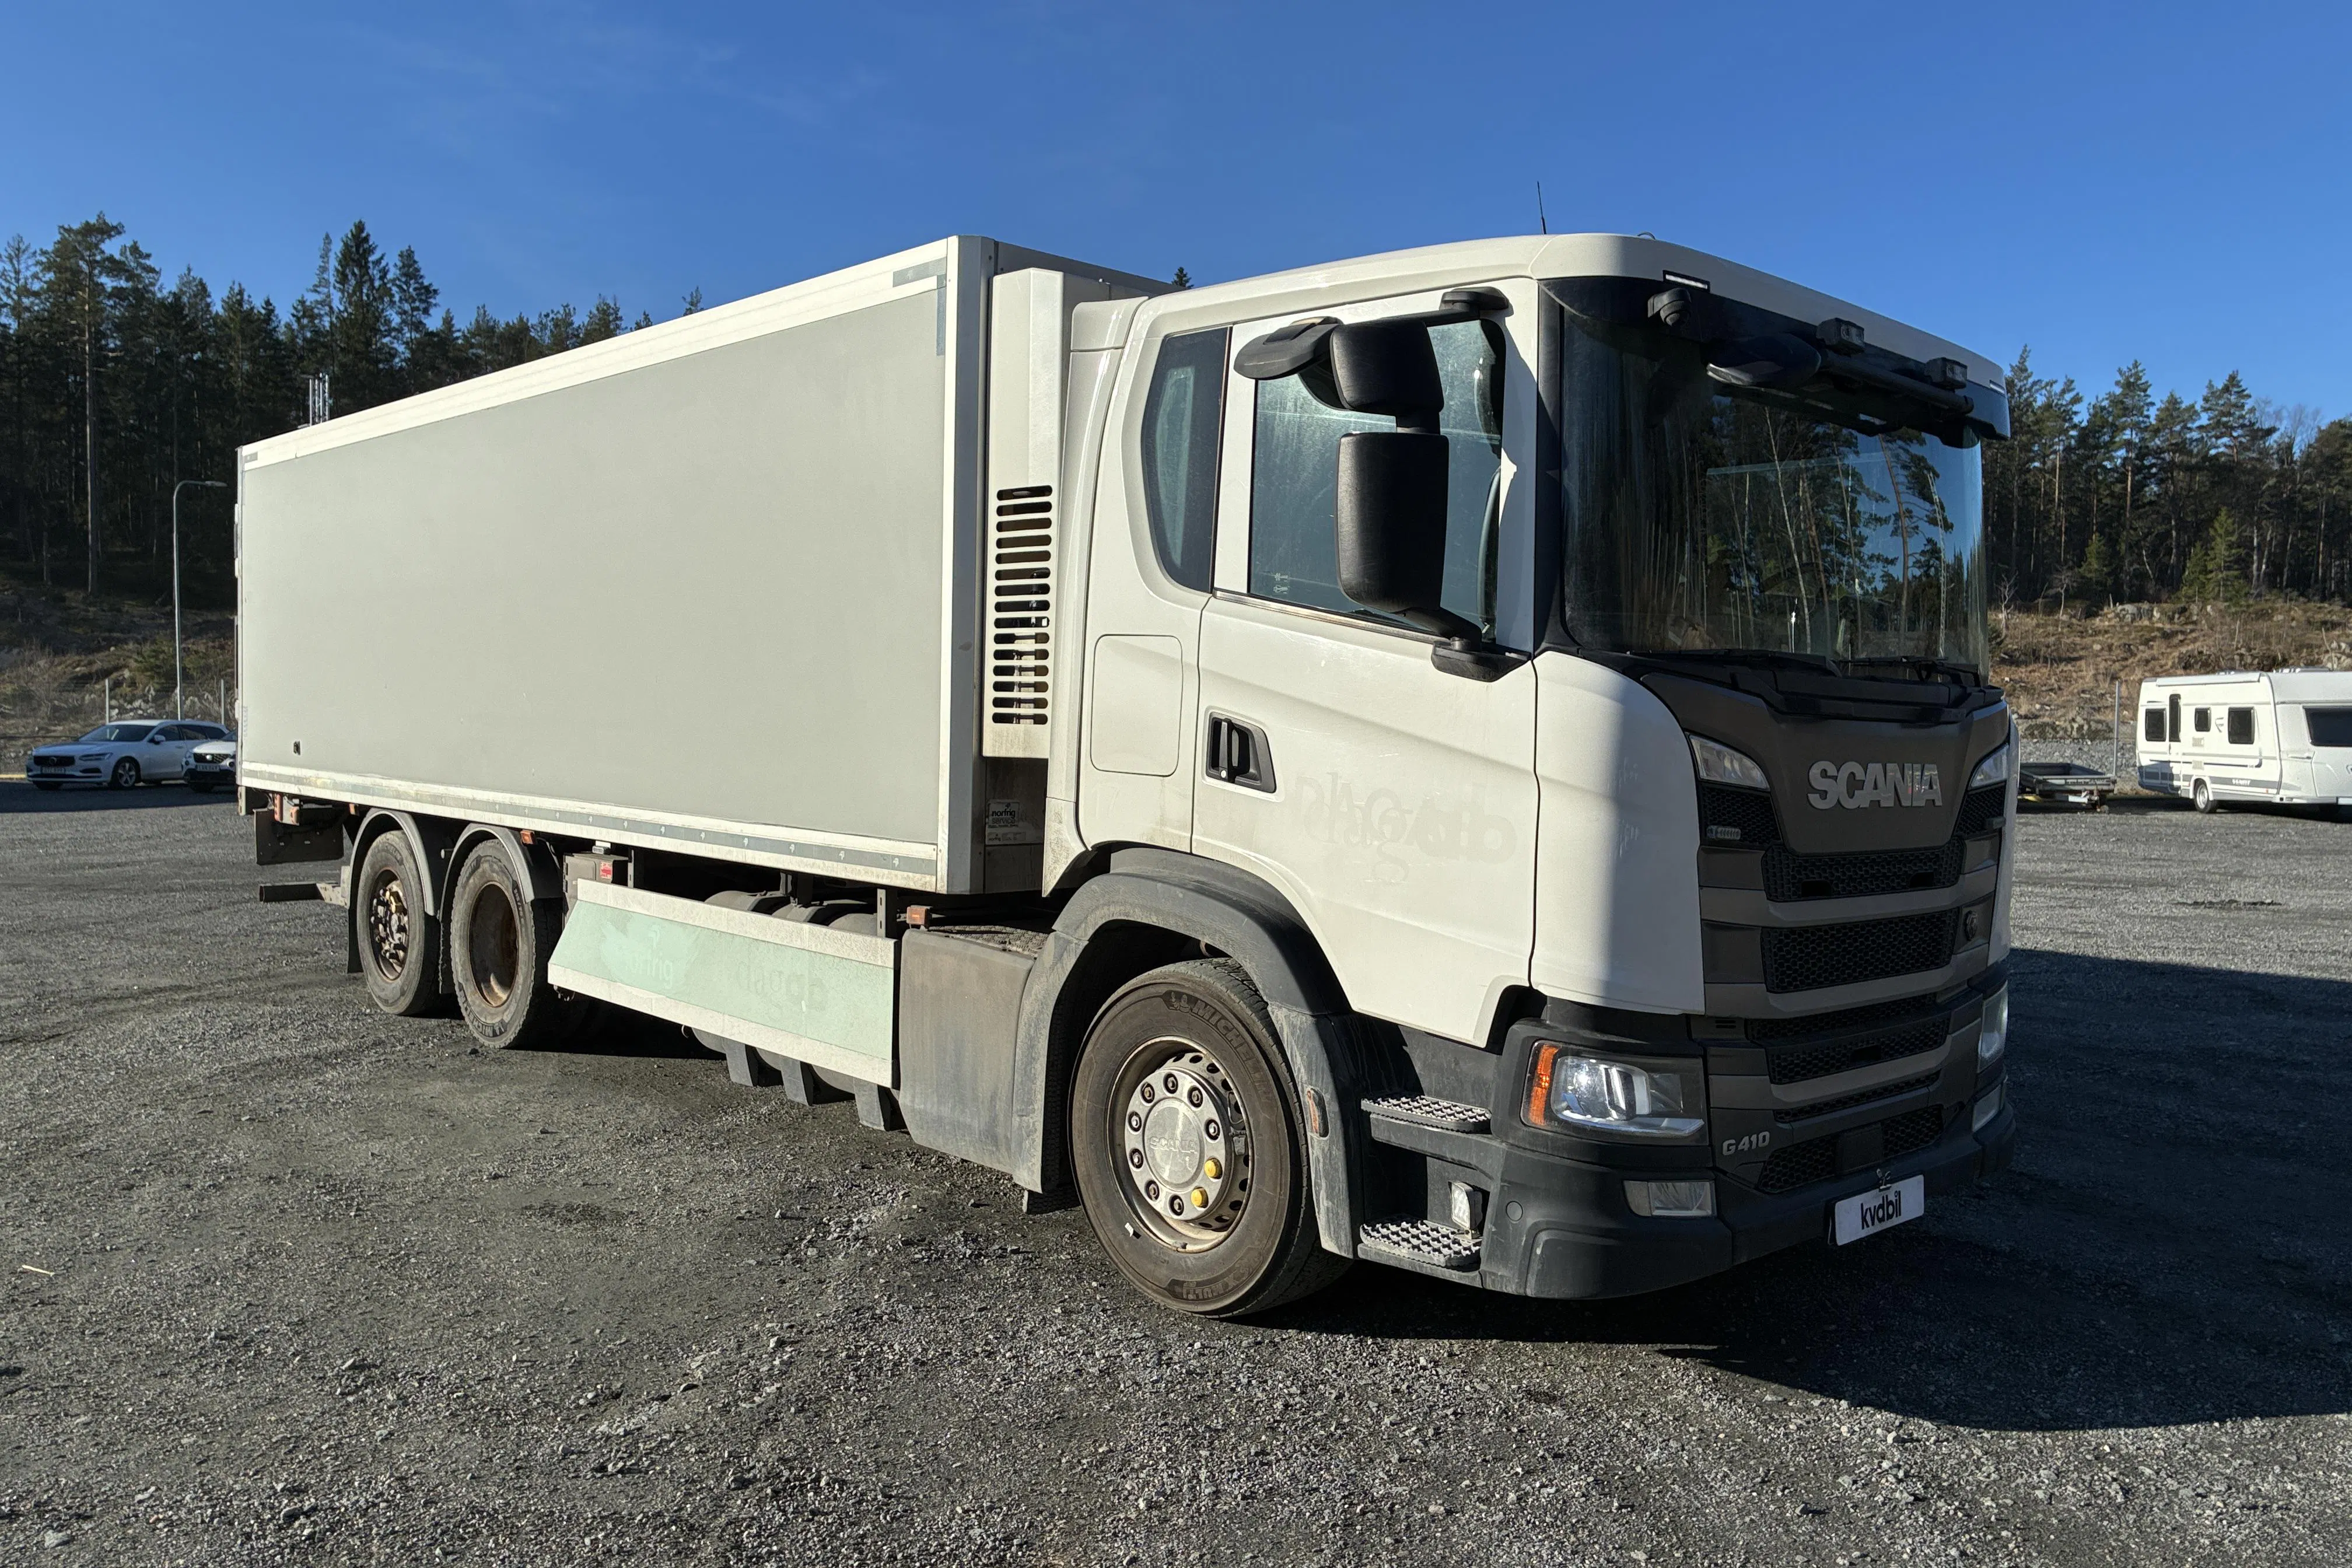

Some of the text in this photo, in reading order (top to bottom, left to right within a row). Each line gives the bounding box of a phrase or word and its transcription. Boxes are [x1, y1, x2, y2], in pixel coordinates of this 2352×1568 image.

[1807, 760, 1943, 810] SCANIA
[1192, 999, 1276, 1102] MICHELIN
[1721, 1130, 1770, 1156] G410
[1860, 1190, 1902, 1230] kvdbil
